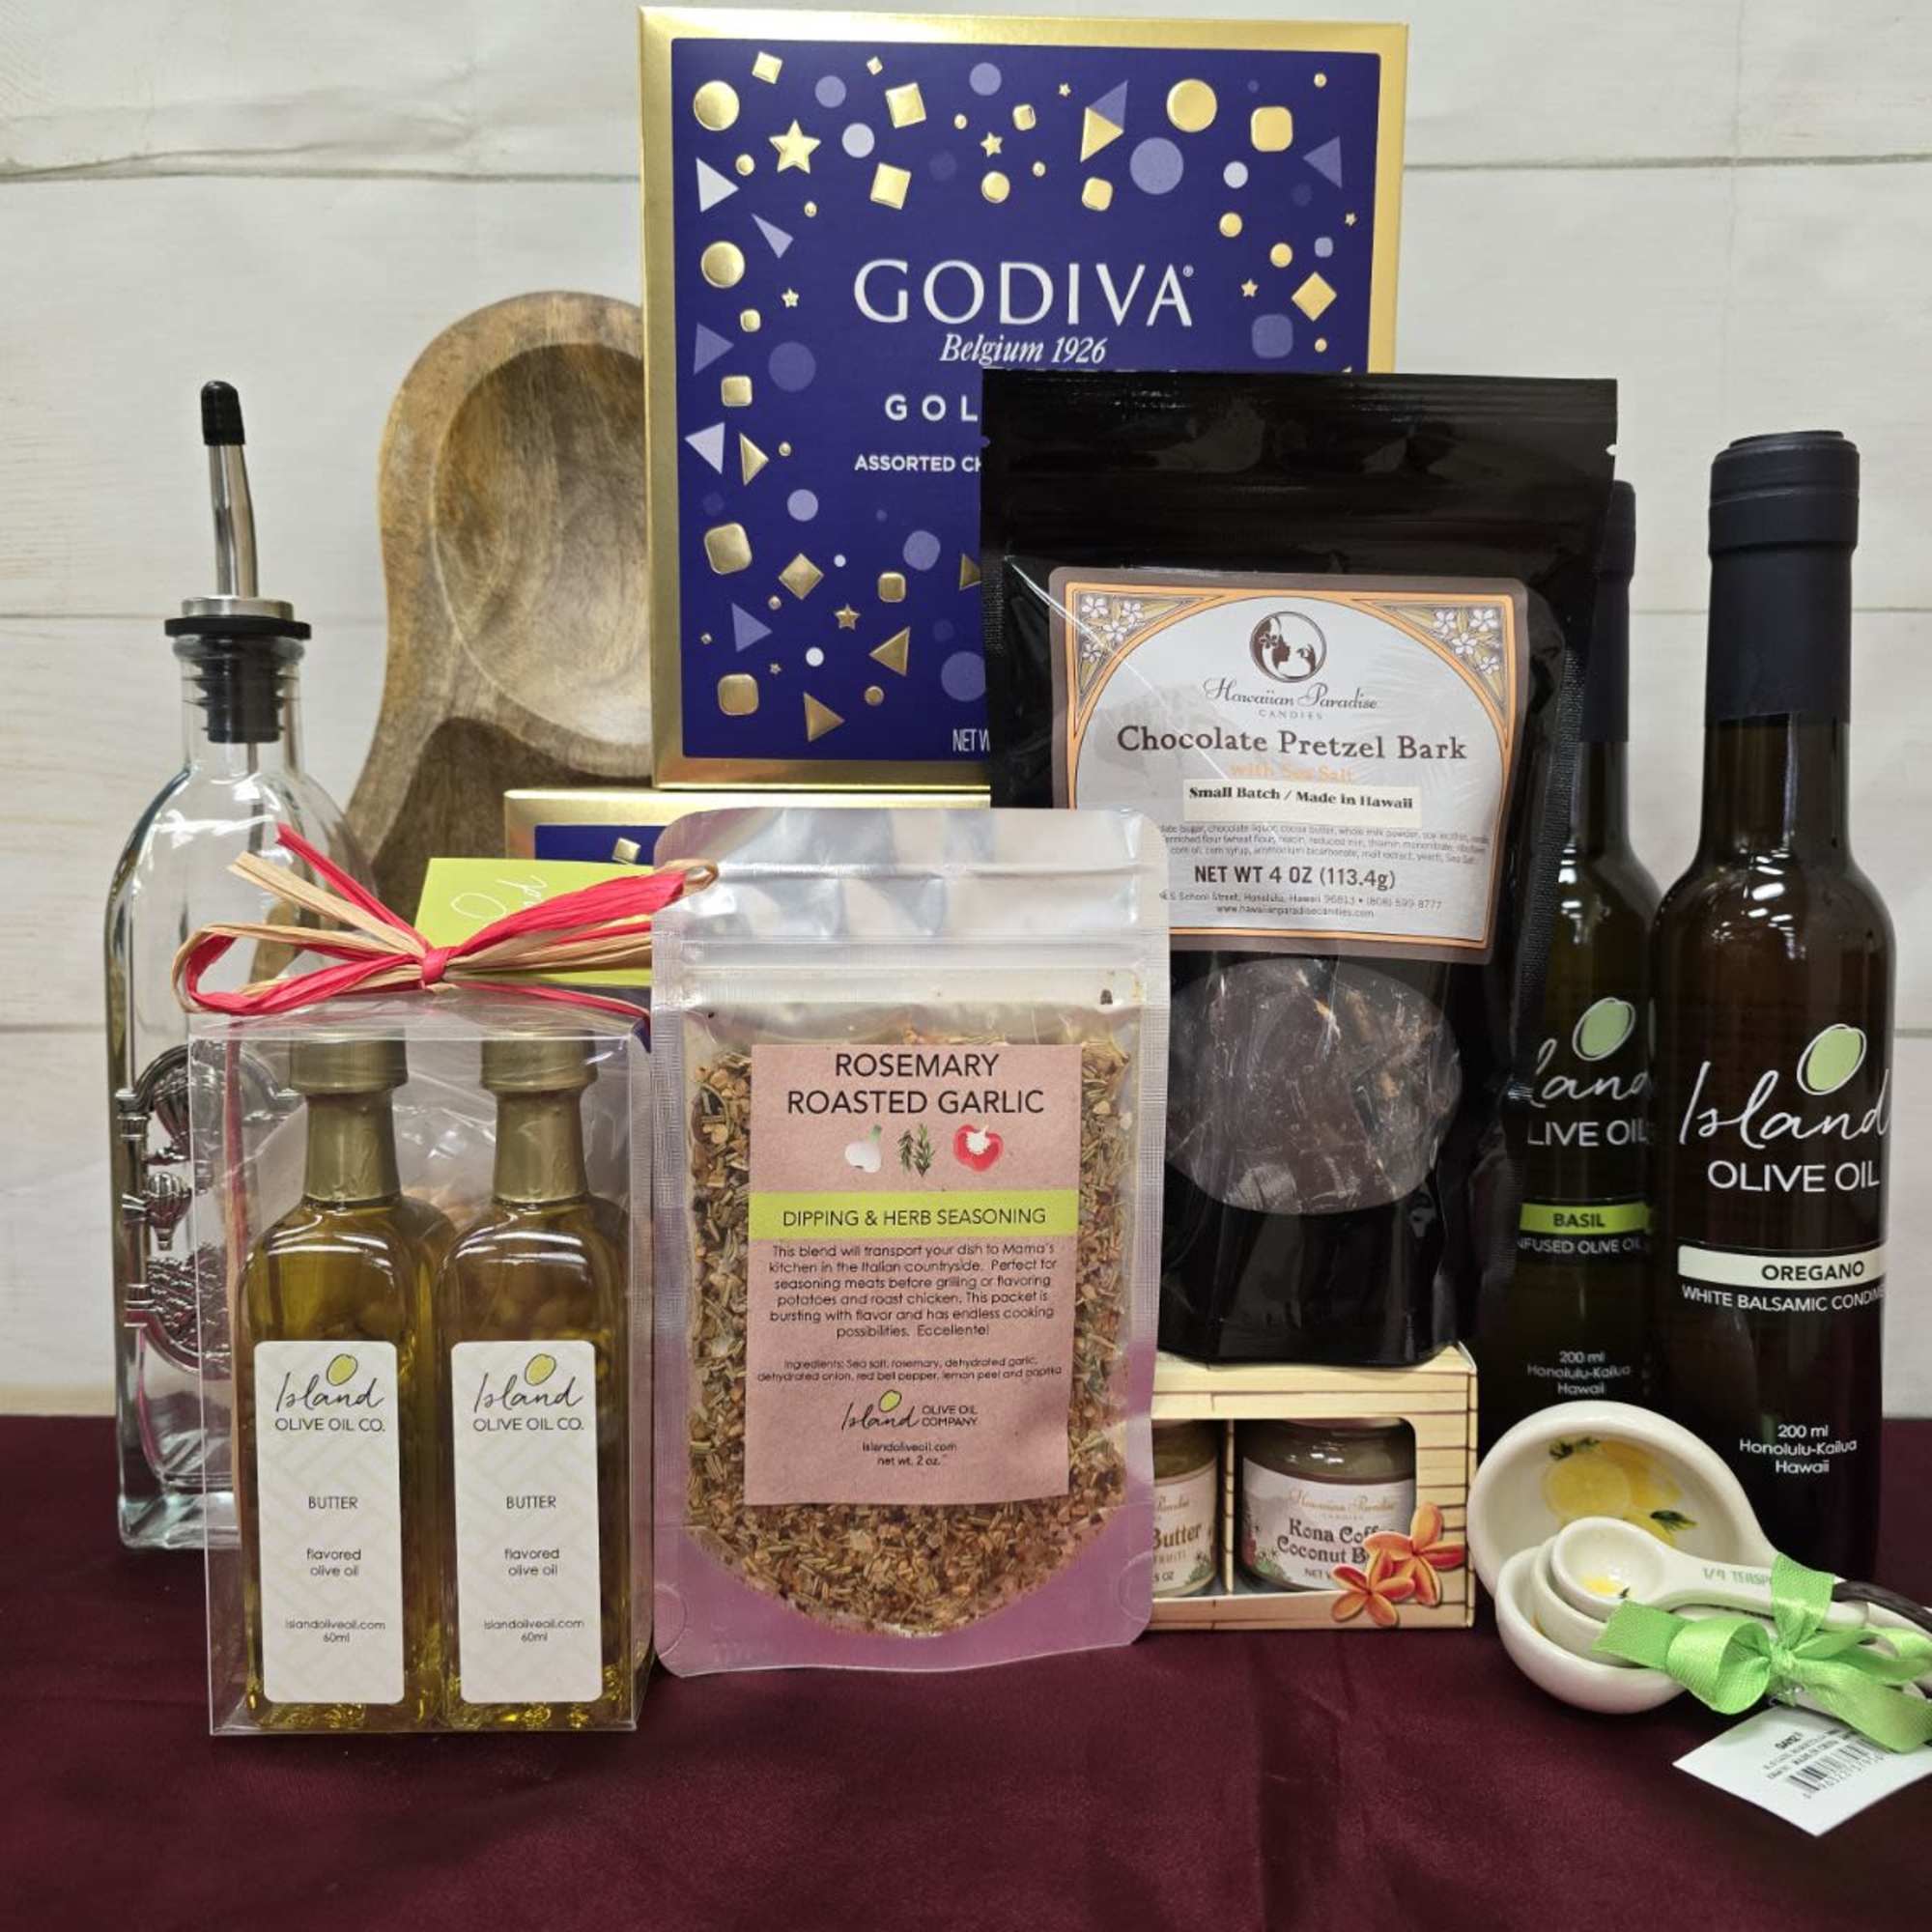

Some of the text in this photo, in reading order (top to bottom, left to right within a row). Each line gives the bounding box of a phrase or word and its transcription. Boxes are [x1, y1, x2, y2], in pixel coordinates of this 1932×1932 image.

[939, 332, 1109, 365] Belgium 1926
[884, 394, 979, 421] GOL
[854, 455, 956, 472] ASSORTED
[1203, 677, 1378, 710] Hawaiian Paradise
[1258, 709, 1323, 721] CANDIES
[952, 728, 977, 752] NET
[1117, 725, 1468, 760] Chocolate Pretzel Bark
[1188, 785, 1233, 800] Small
[1236, 786, 1281, 801] Batch
[1295, 790, 1337, 805] Made
[1340, 792, 1356, 806] in
[1359, 795, 1413, 810] Hawaii
[1194, 865, 1397, 892] NET WT 4 OZ (113.4g)
[836, 1053, 1000, 1077] ROSEMARY
[787, 1089, 1045, 1115] ROASTED GARLIC
[1679, 1061, 1890, 1150] Island
[1527, 1122, 1600, 1148] LIVE
[1708, 1160, 1881, 1192] OLIVE OIL
[782, 1208, 1047, 1228] DIPPING & HERB SEASONING
[1552, 1212, 1606, 1229] BASIL
[773, 1242, 1055, 1260] This blend will transport your dish to Mama's
[1577, 1239, 1620, 1255] OLIVE
[769, 1262, 817, 1273] kitchen
[821, 1262, 833, 1273] in
[837, 1262, 858, 1273] the
[862, 1261, 900, 1273] Italian
[991, 1259, 1037, 1271] Perfect
[1040, 1259, 1057, 1270] for
[1761, 1261, 1864, 1282] OREGANO
[774, 1274, 1051, 1292] seasoning meats before grilling or flavoring
[777, 1291, 1048, 1308] potatoes and roast chicken. This packet is
[1682, 1284, 1733, 1307] WHITE
[1737, 1295, 1829, 1313] BALSAMIC
[770, 1306, 1055, 1323] bursting with flavor and has endless cooking
[836, 1323, 990, 1340] possibilities. Eccellente!
[846, 1359, 867, 1370] Sea
[944, 1357, 1006, 1370] dehydrated
[1559, 1350, 1605, 1363] 200 ml
[757, 1371, 820, 1382] dehydrated
[856, 1371, 874, 1381] red
[876, 1371, 896, 1381] bell
[943, 1370, 975, 1380] lemon
[977, 1369, 1001, 1381] peel
[1003, 1368, 1023, 1378] and
[275, 1371, 385, 1413] Island
[473, 1371, 583, 1414] Island
[1557, 1381, 1605, 1395] Hawaii
[274, 1417, 386, 1433] OLIVE OIL CO.
[472, 1417, 584, 1432] OLIVE OIL CO.
[840, 1402, 979, 1432] Island OLIVE OIL
[922, 1416, 979, 1427] COMPANY
[1776, 1424, 1829, 1438] 200 ml
[1739, 1438, 1858, 1456] Honolulu-Kailua
[877, 1456, 895, 1466] net
[916, 1455, 924, 1466] 2
[1775, 1460, 1831, 1475] Hawaii
[308, 1496, 359, 1510] BUTTER
[506, 1495, 557, 1510] BUTTER
[1289, 1517, 1335, 1543] Kona
[306, 1547, 362, 1561] flavored
[504, 1547, 560, 1560] flavored
[1276, 1534, 1347, 1564] Coconut
[310, 1564, 360, 1577] olive oil
[508, 1564, 558, 1577] olive oil
[323, 1632, 350, 1643] 60ml
[521, 1631, 549, 1643] 60ml
